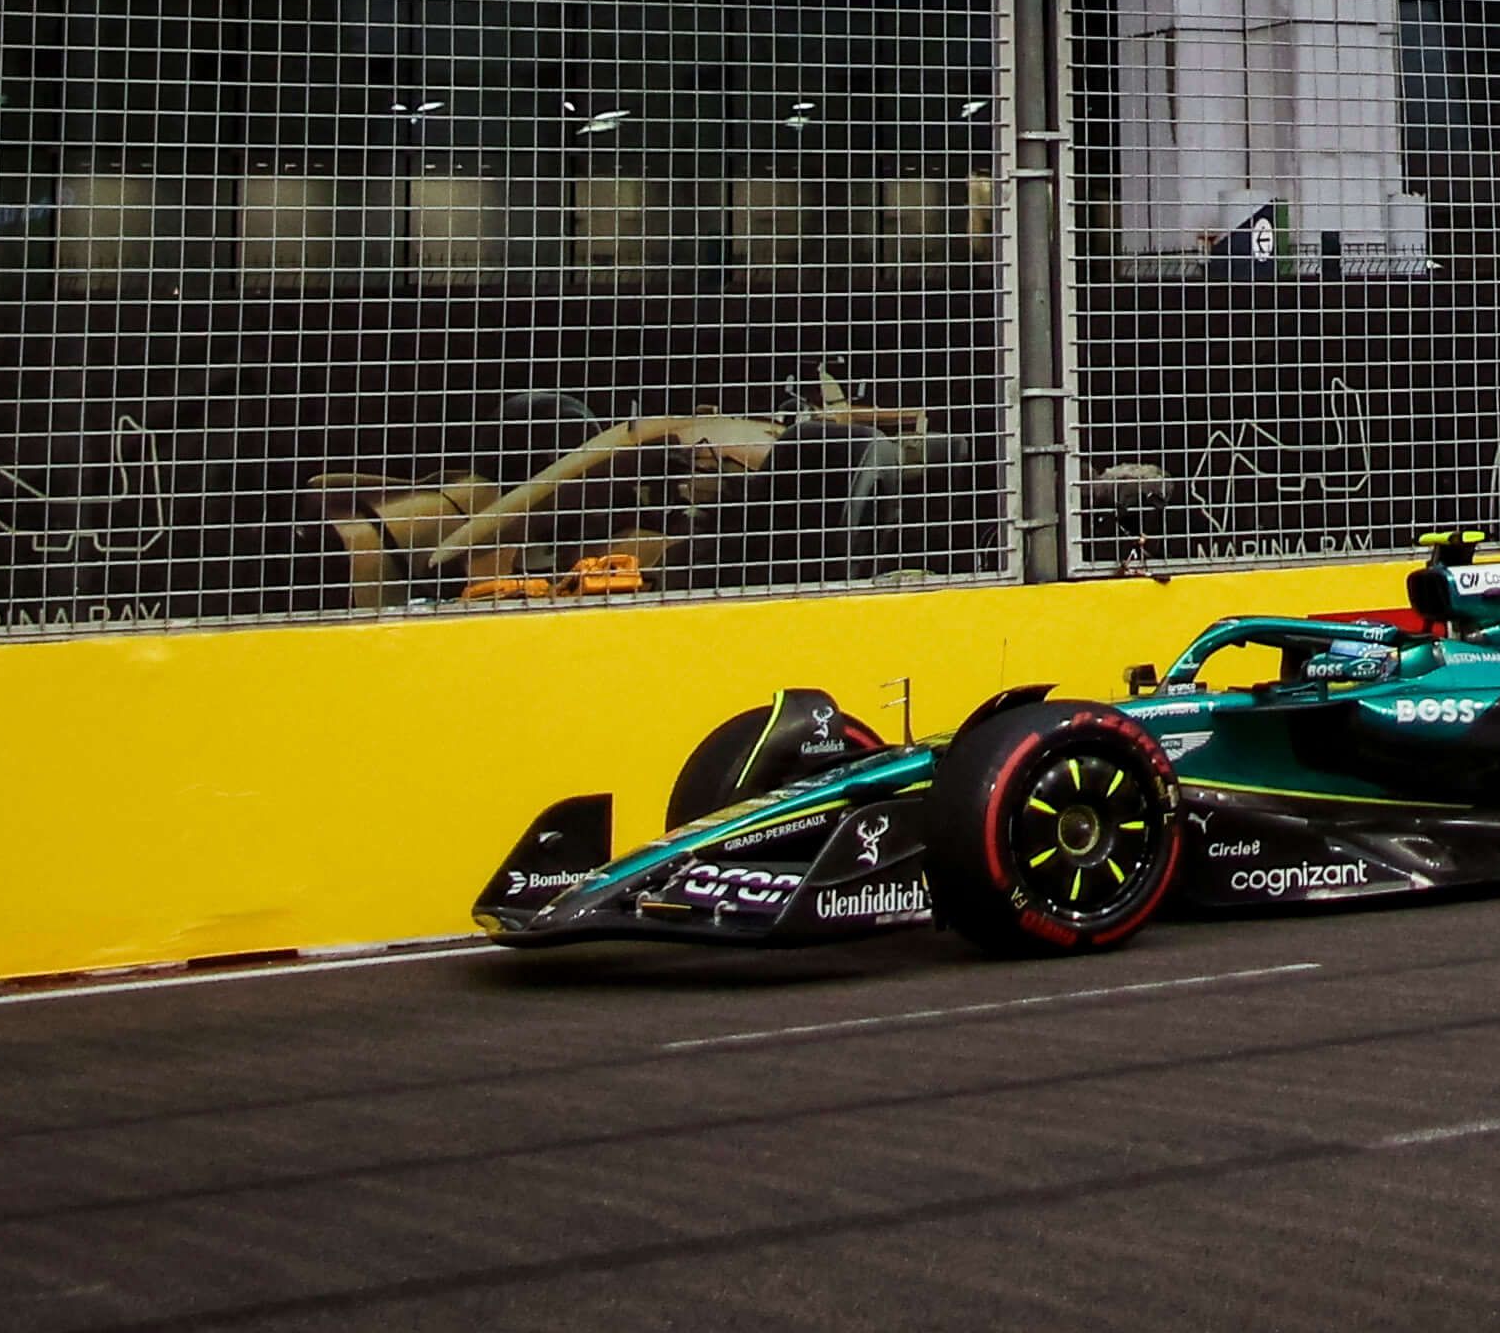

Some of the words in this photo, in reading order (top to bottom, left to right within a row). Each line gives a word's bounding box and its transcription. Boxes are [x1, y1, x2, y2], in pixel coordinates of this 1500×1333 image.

[1196, 536, 1307, 559] MARINA
[1306, 661, 1344, 677] BOSS
[1396, 698, 1476, 724] BOSS
[800, 737, 845, 754] Glenfiddich
[724, 811, 828, 852] GIRARD-PERREGAUX
[1230, 858, 1369, 897] cognizant
[816, 879, 927, 921] Glenfiddich
